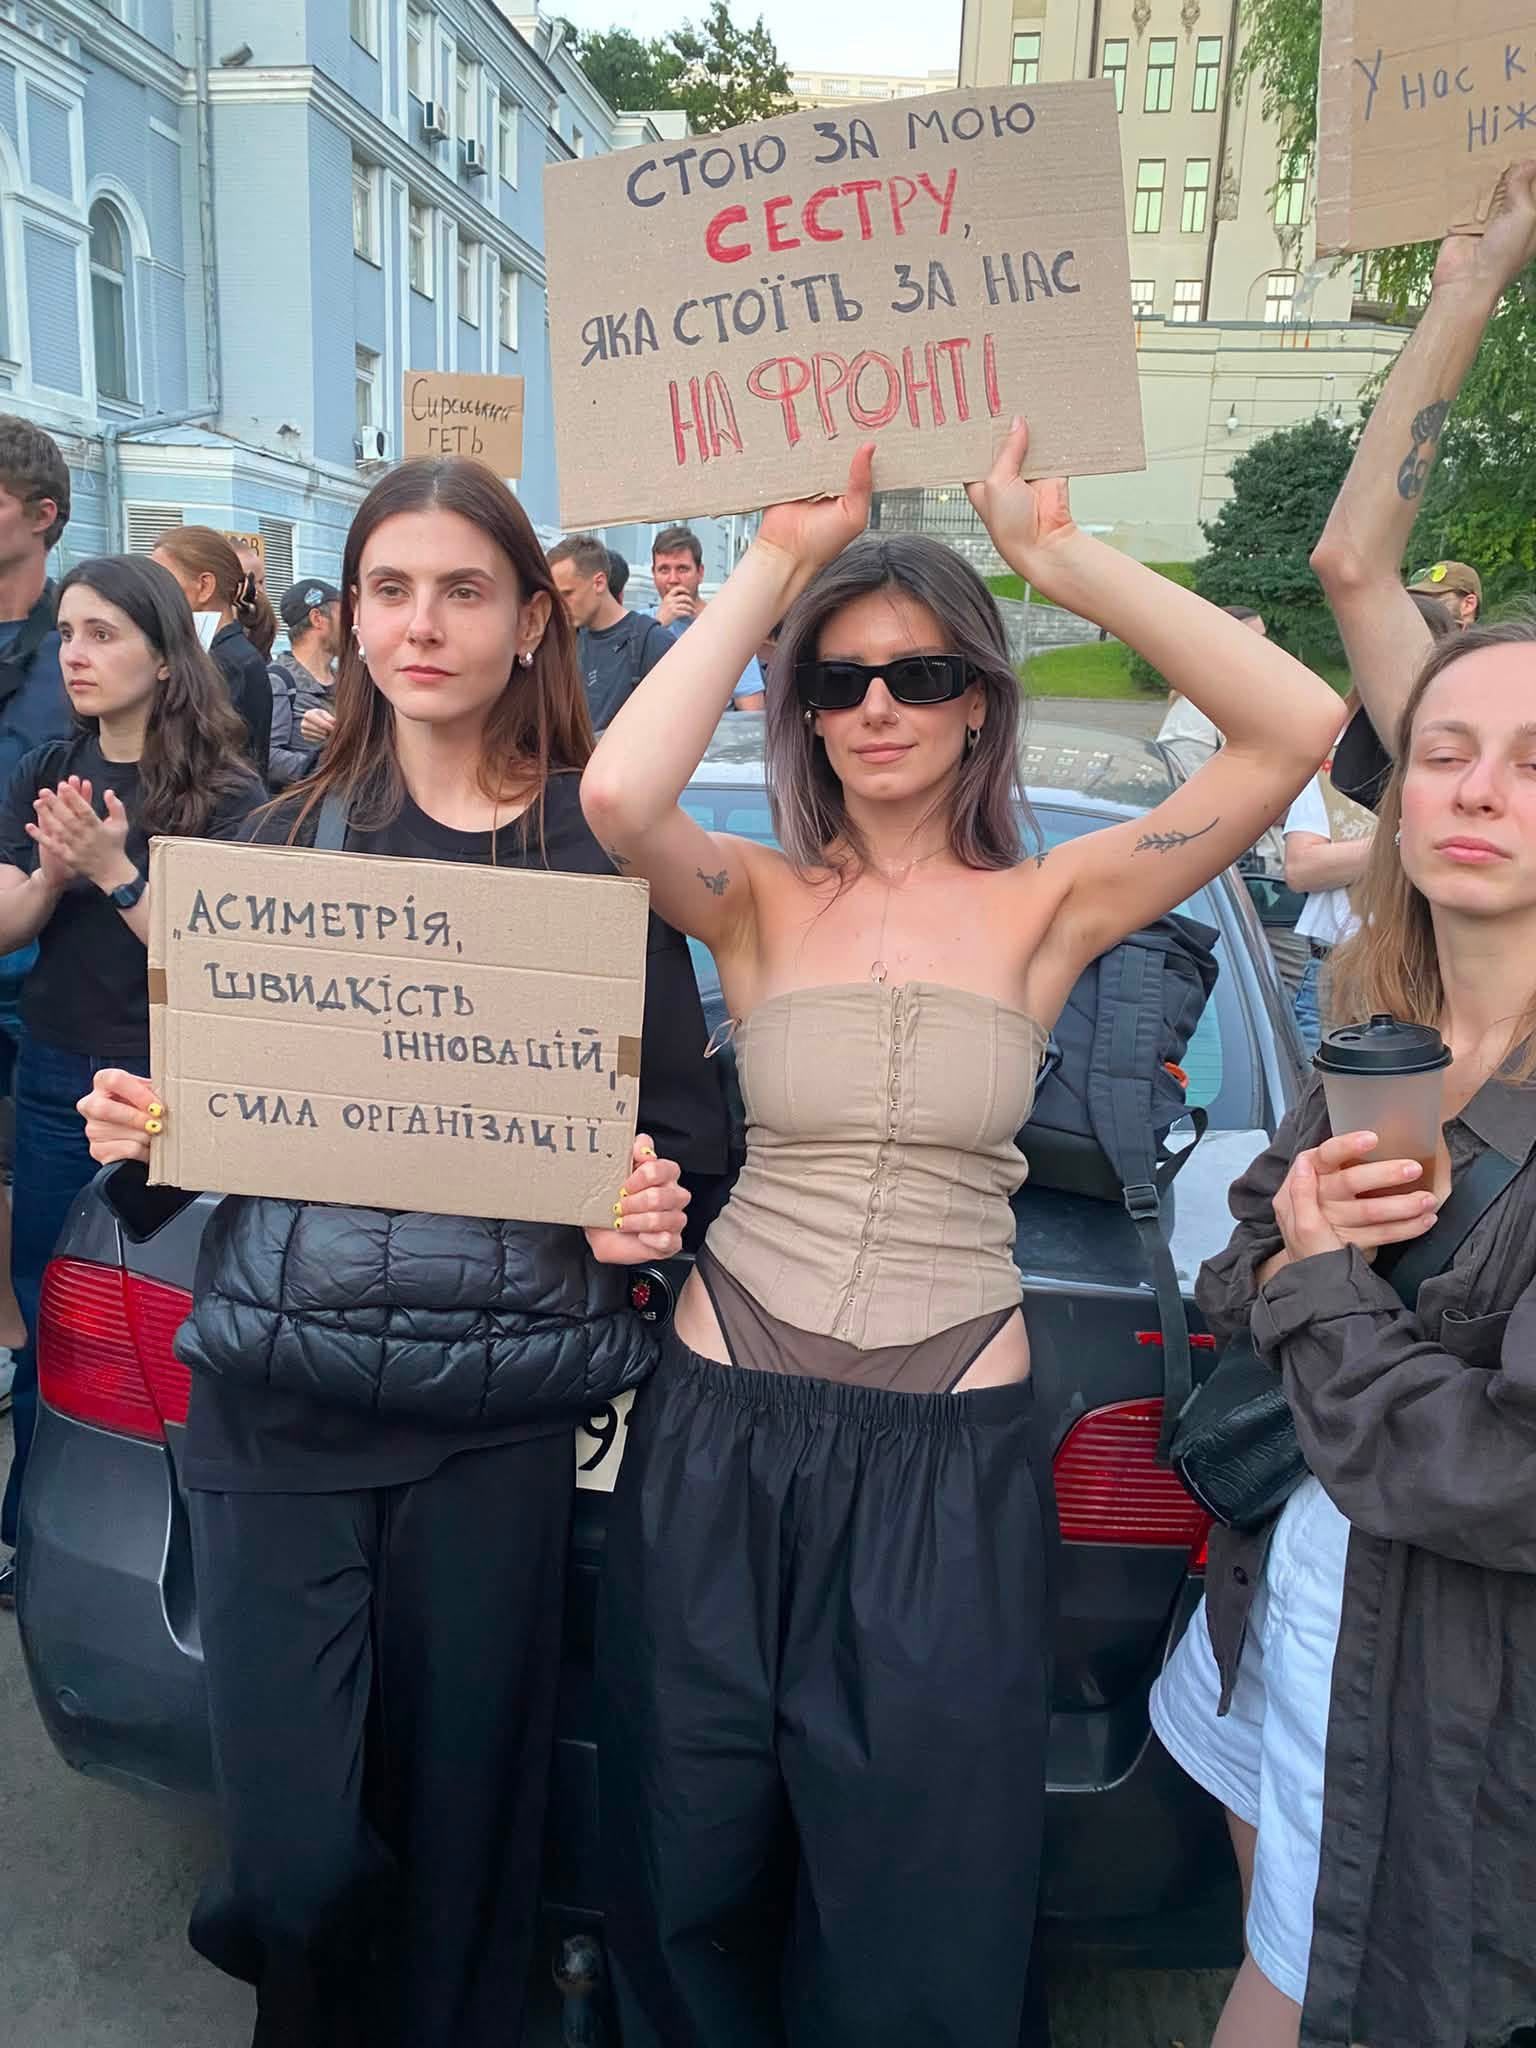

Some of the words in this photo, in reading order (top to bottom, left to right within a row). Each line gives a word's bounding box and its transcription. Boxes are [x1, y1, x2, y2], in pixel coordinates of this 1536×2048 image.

[1353, 49, 1383, 121] У
[626, 132, 787, 208] СТОЮ
[812, 116, 880, 166] ЗА
[906, 100, 1036, 150] МОЮ
[580, 305, 660, 367] ЯКА
[672, 272, 863, 346] СТОЇТЬ
[891, 260, 956, 313] ЗА
[982, 250, 1081, 305] НАС
[669, 370, 744, 465] НА
[746, 333, 1003, 448] ФРОНТІ
[428, 425, 484, 455] ГЕТЬ
[207, 1092, 319, 1128] СИЛА
[577, 1400, 632, 1472] 9
